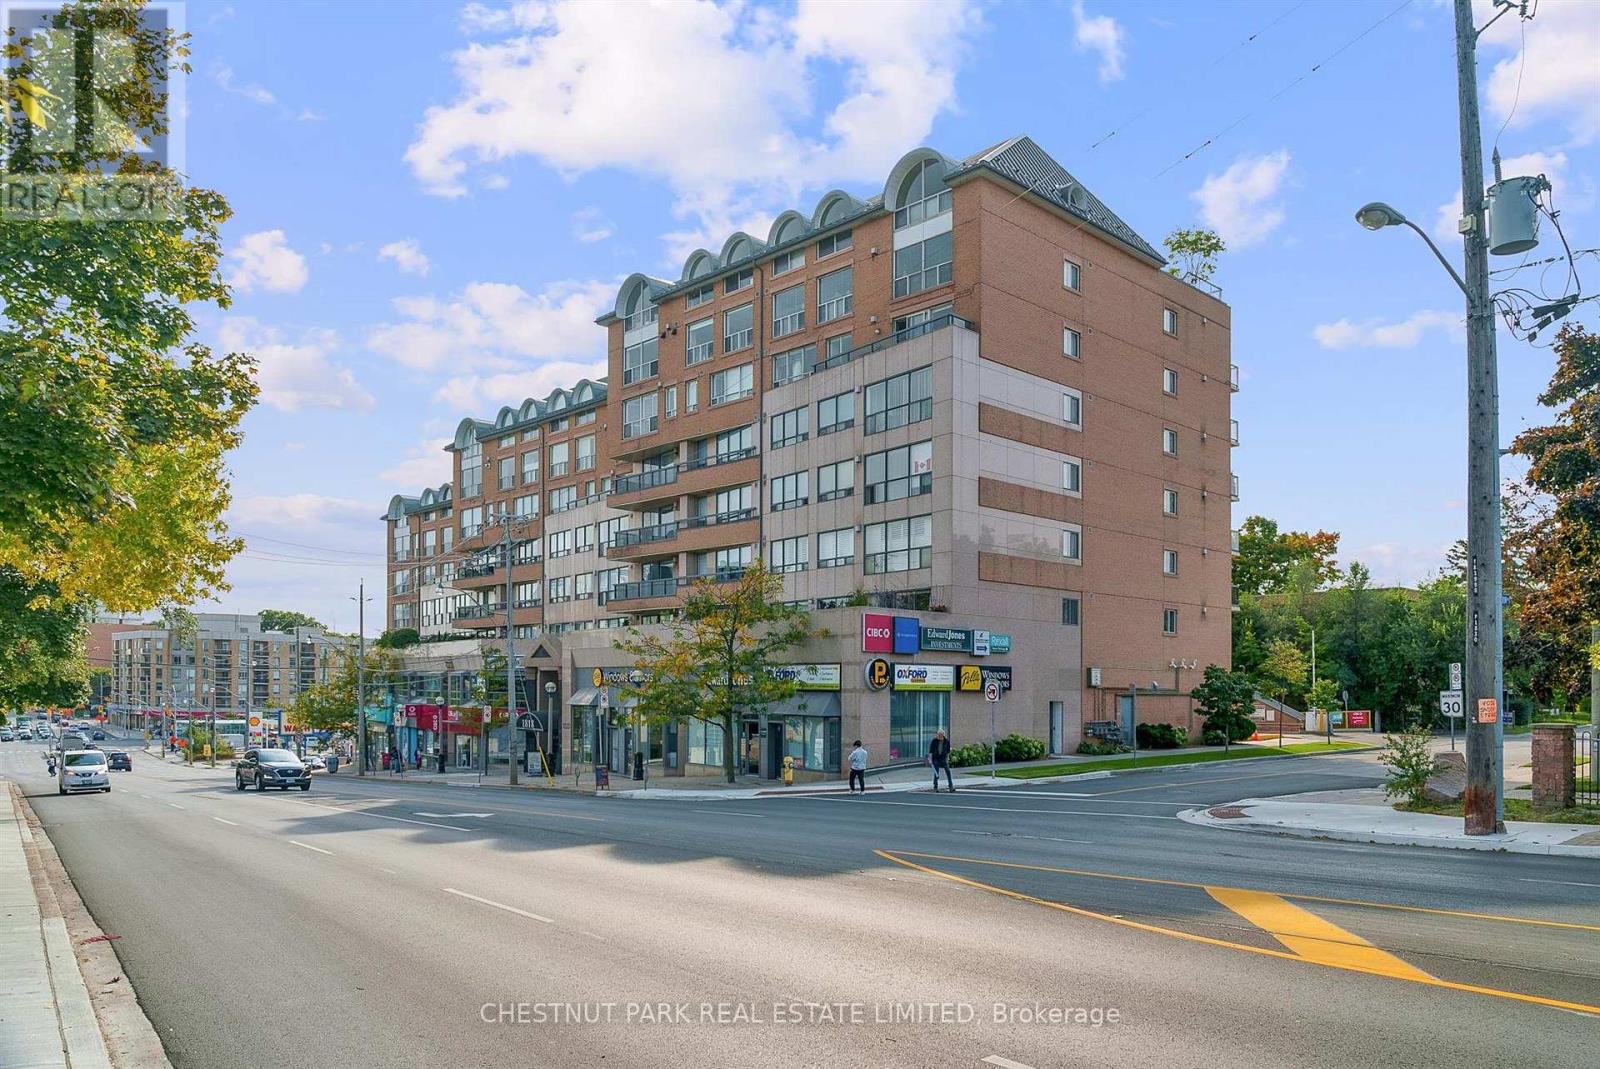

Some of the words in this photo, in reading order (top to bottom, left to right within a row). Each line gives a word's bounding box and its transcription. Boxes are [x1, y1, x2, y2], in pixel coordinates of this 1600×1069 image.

[866, 627, 883, 638] CIBC
[930, 640, 962, 649] INVESTMENTS
[897, 666, 928, 679] OXFORD
[1443, 701, 1461, 713] 30
[283, 724, 311, 732] WAH
